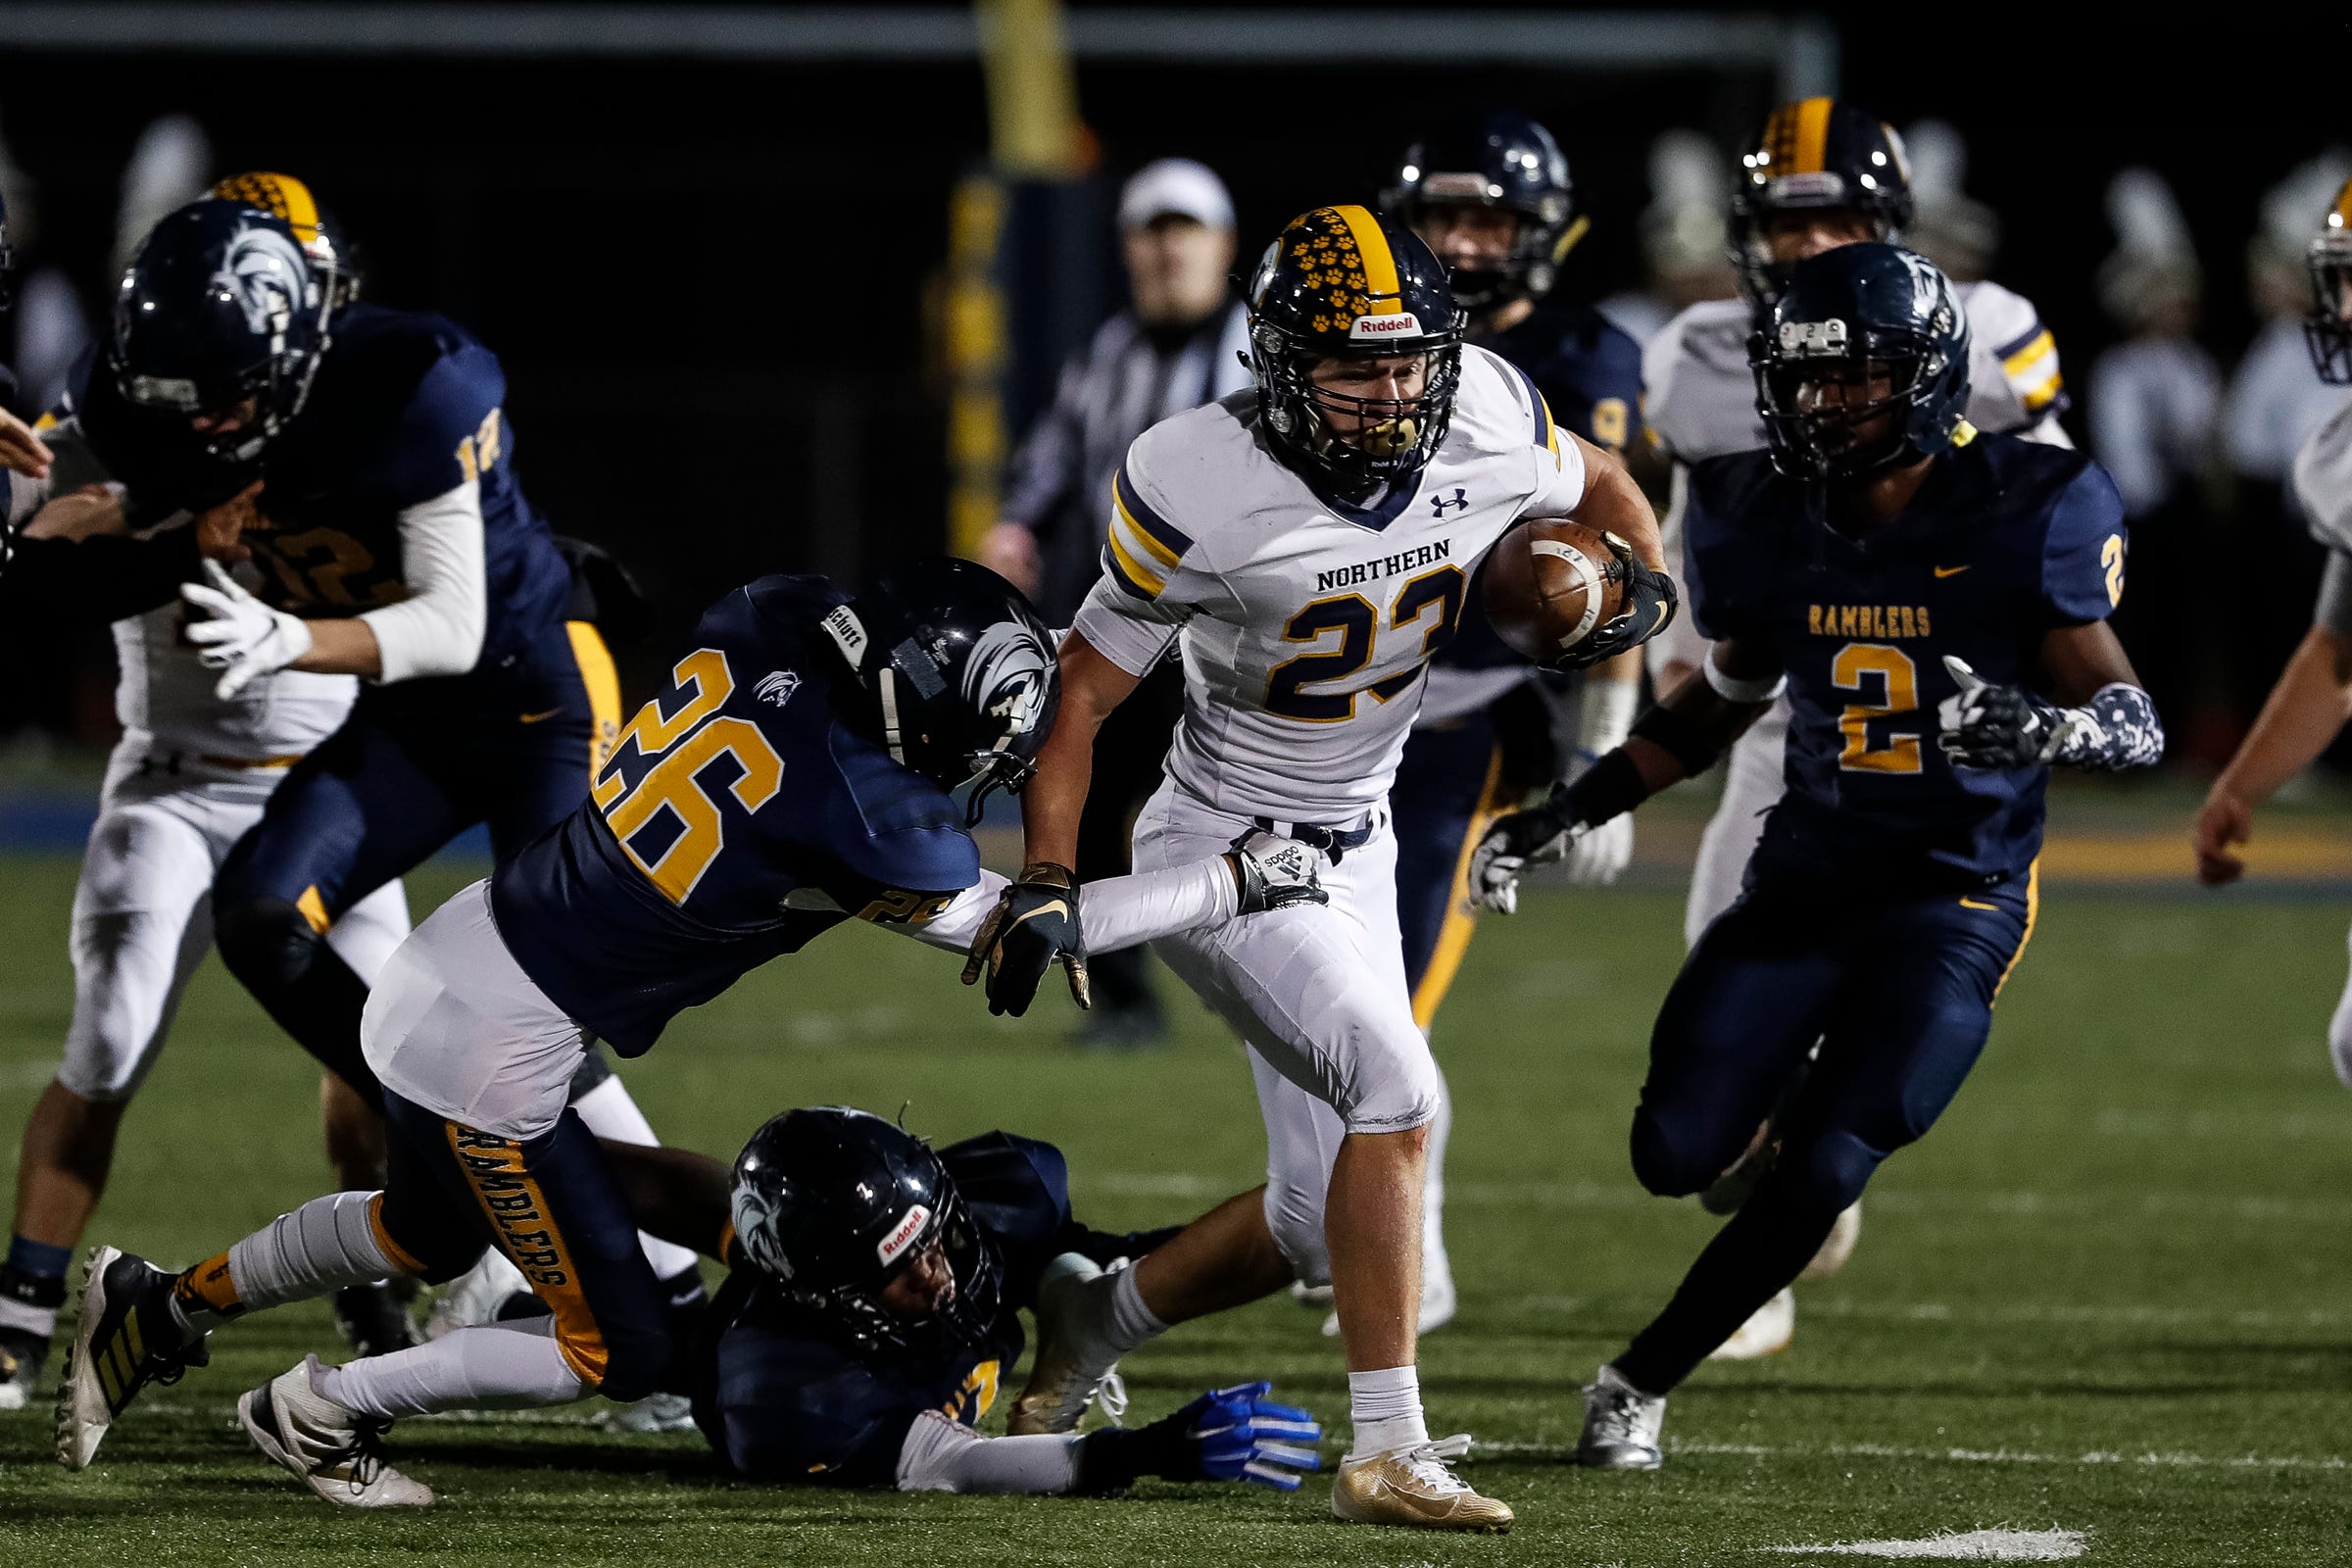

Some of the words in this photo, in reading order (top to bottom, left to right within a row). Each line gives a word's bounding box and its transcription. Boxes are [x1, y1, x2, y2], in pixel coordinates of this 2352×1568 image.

[1360, 317, 1413, 333] Riddell
[1317, 539, 1450, 592] NORTHERN
[1262, 564, 1467, 723] 23
[1808, 604, 1931, 638] RAMBLERS
[1832, 642, 1923, 774] 2
[591, 648, 785, 907] 26
[1264, 846, 1299, 867] adidas
[456, 1127, 568, 1288] RAMBLERS
[884, 1210, 922, 1254] Riddell
